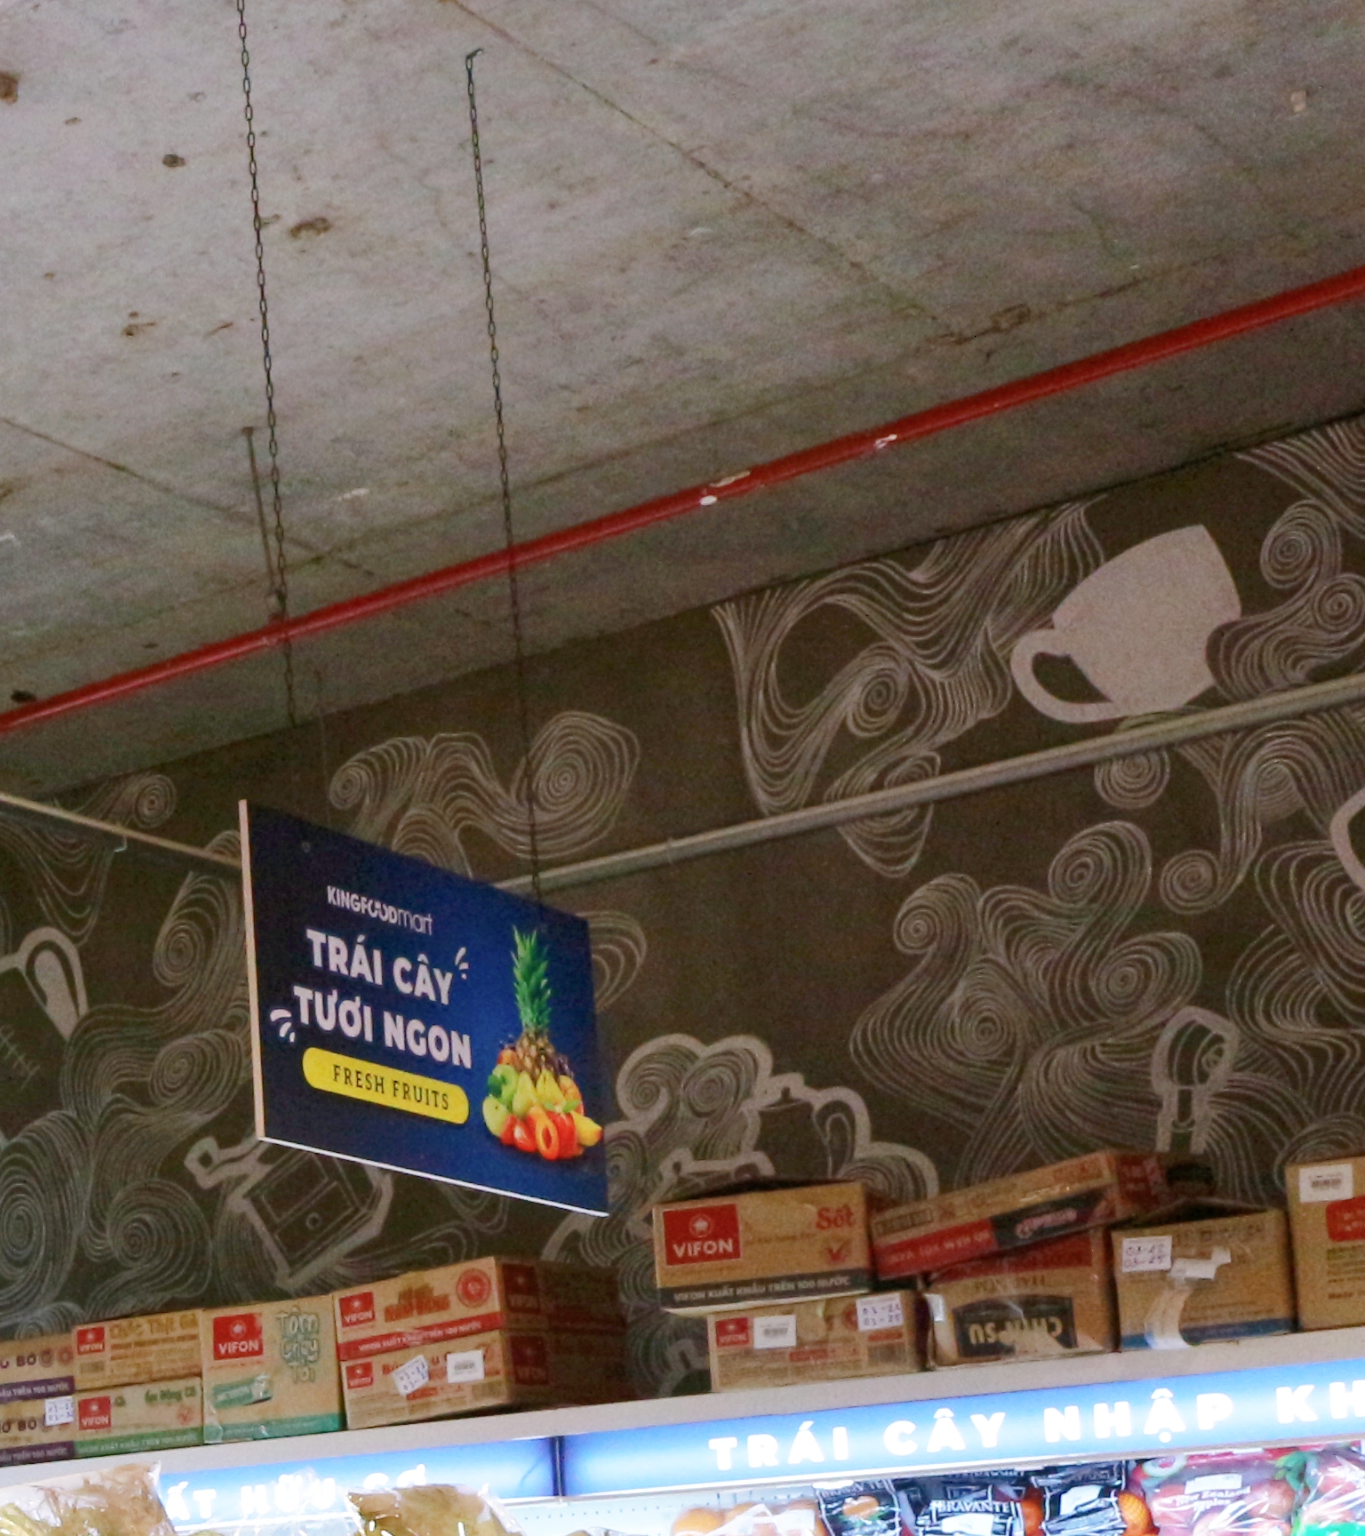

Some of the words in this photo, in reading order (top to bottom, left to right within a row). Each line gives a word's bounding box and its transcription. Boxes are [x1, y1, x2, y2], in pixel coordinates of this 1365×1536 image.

[306, 928, 383, 985] TRÁI
[393, 953, 453, 1005] CÂY
[293, 986, 373, 1042] TƯƠI
[383, 1015, 472, 1069] NGON
[333, 1065, 385, 1095] FRESH
[393, 1082, 450, 1112] FRUITS
[673, 1239, 733, 1258] VIFON
[674, 1291, 705, 1302] VIFON
[345, 1311, 373, 1322] VIFON
[79, 1342, 104, 1352] VIFON
[219, 1340, 259, 1354] VIFON
[82, 1416, 110, 1426] VIFON
[709, 1421, 849, 1470] TRÁI
[884, 1408, 1005, 1455] CÂY
[1044, 1388, 1234, 1443] NHẬP
[1276, 1379, 1365, 1424] KH
[241, 1474, 336, 1513] HỮU
[1202, 1486, 1251, 1499] Zealand
[938, 1501, 1011, 1513] BRAVANTE
